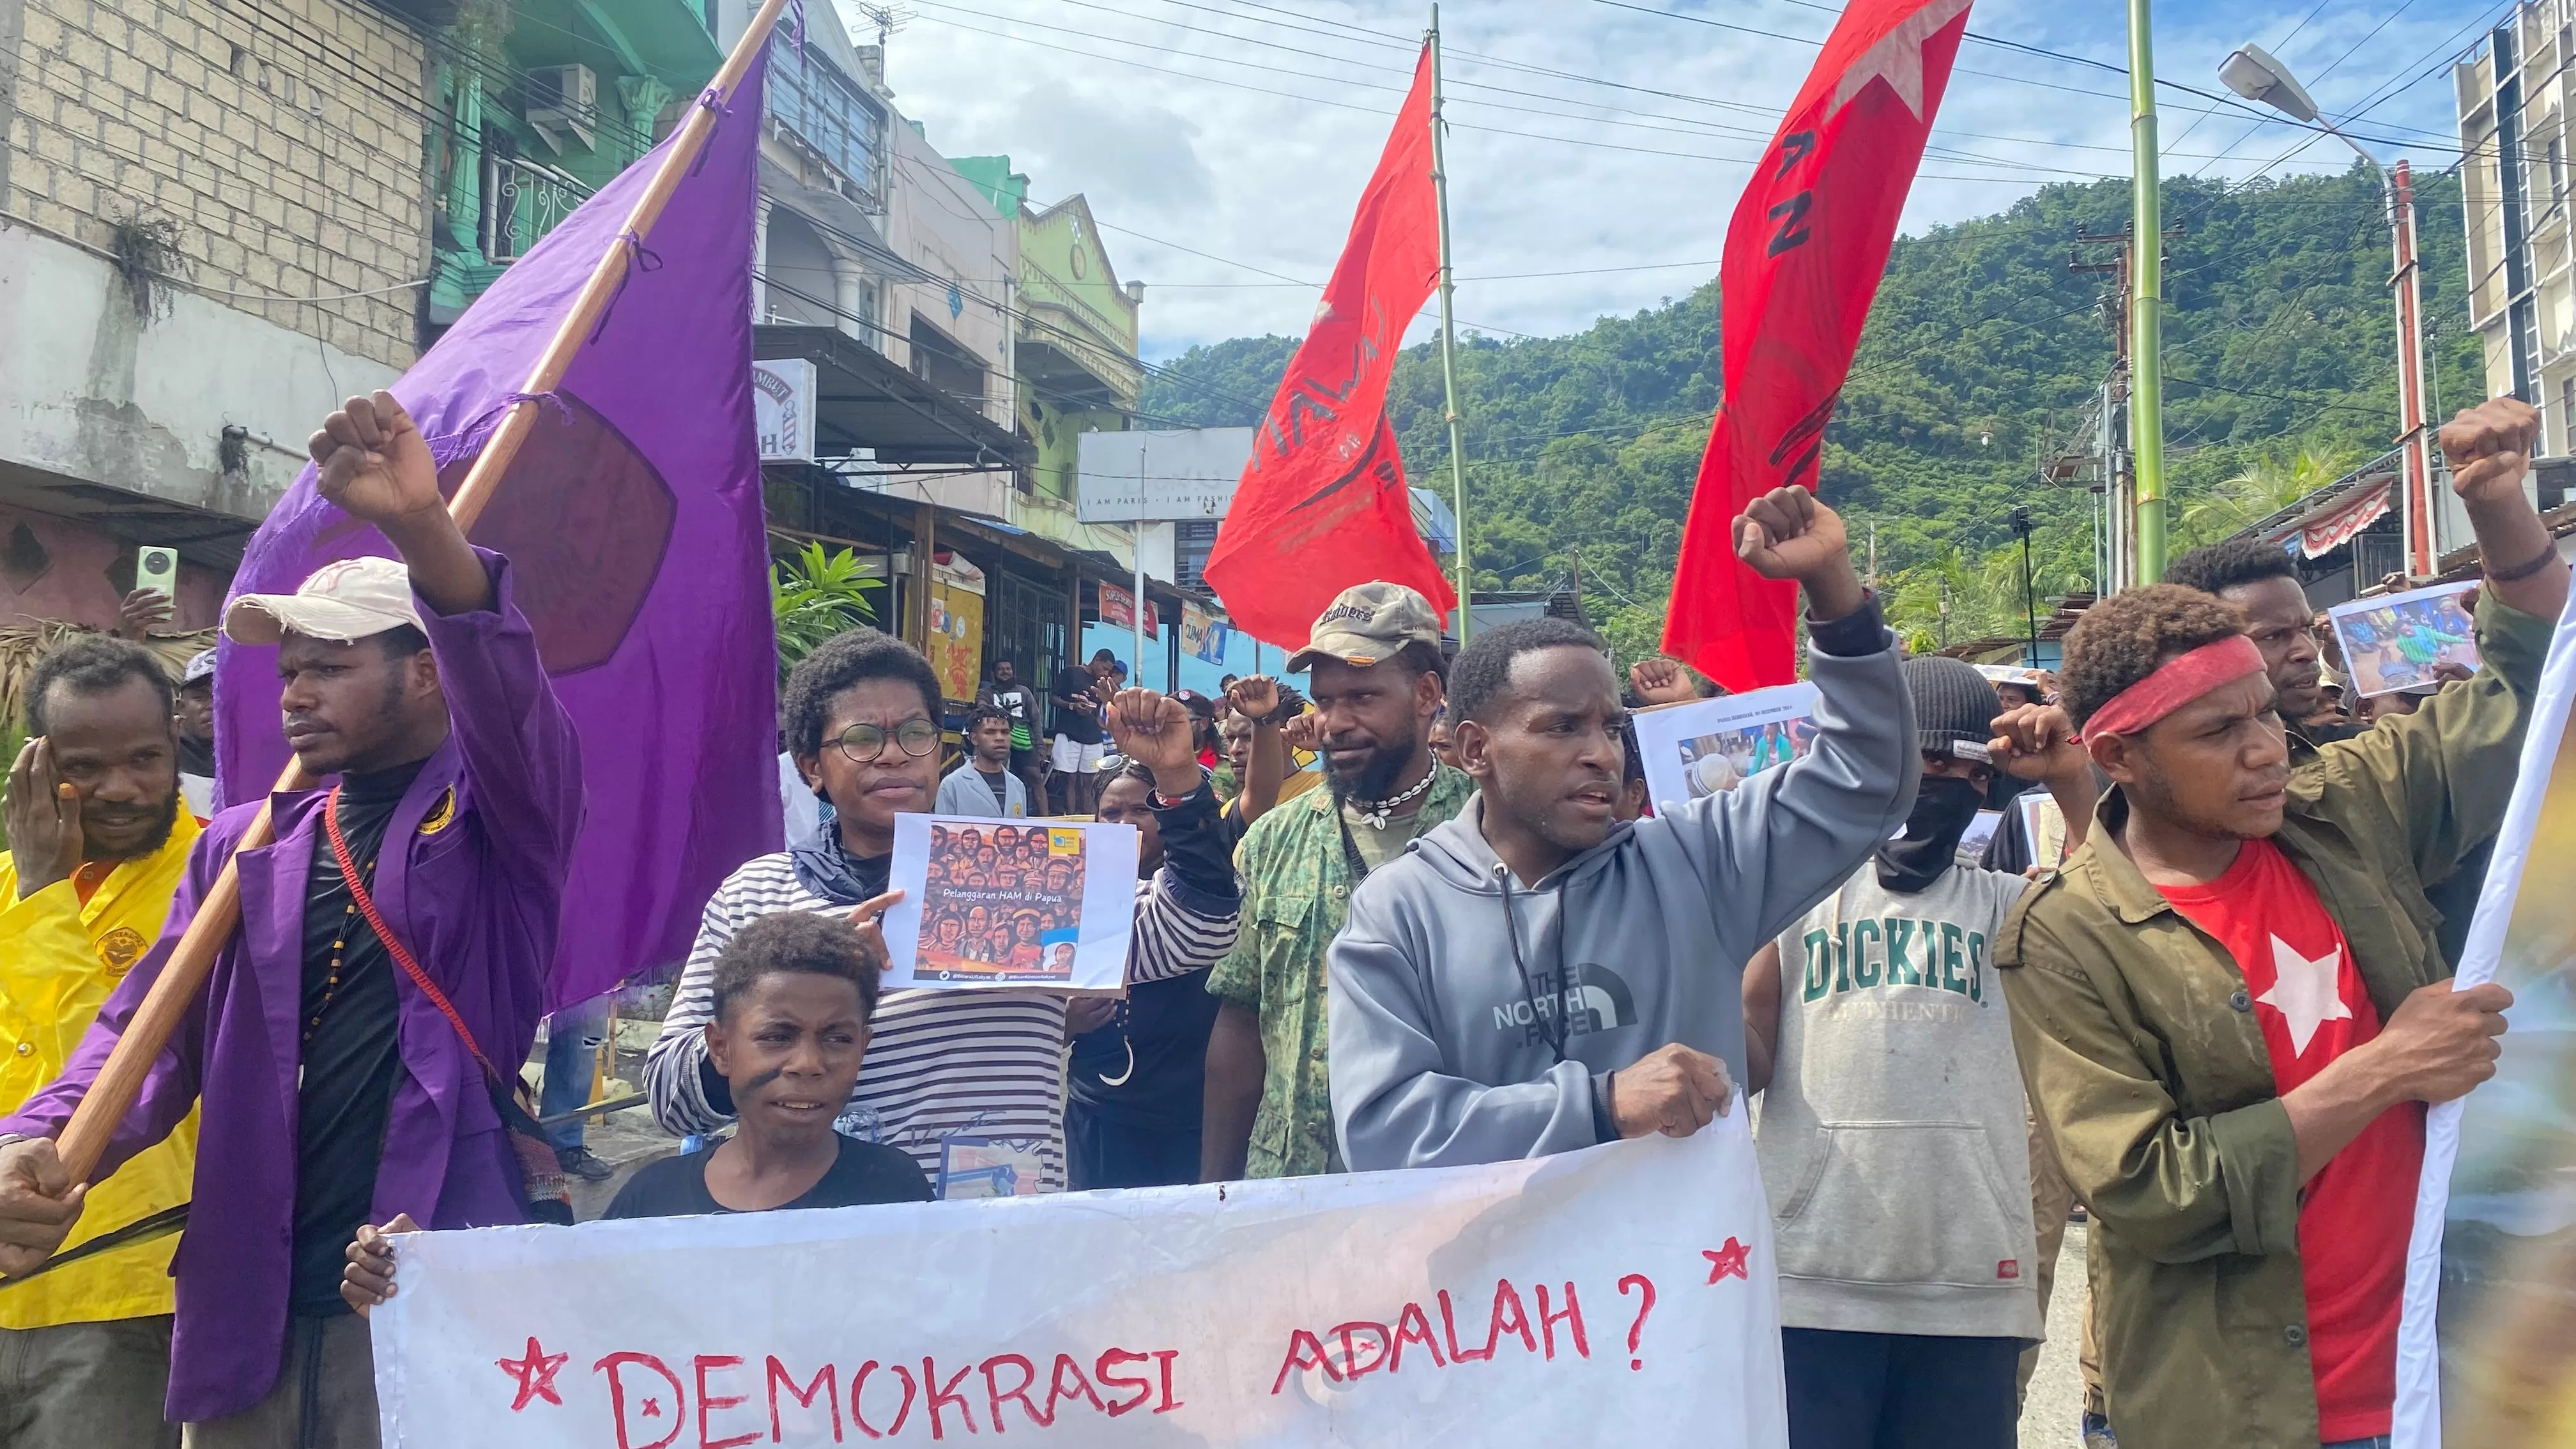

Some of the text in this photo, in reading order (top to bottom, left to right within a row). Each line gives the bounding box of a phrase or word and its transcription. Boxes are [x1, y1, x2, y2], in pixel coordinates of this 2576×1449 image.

[943, 888, 1062, 905] Pelanggaran HAM di Papua
[1802, 917, 1984, 1005] DICKIES
[593, 1273, 1657, 1449] DEMOKRASI ADALAH ?
